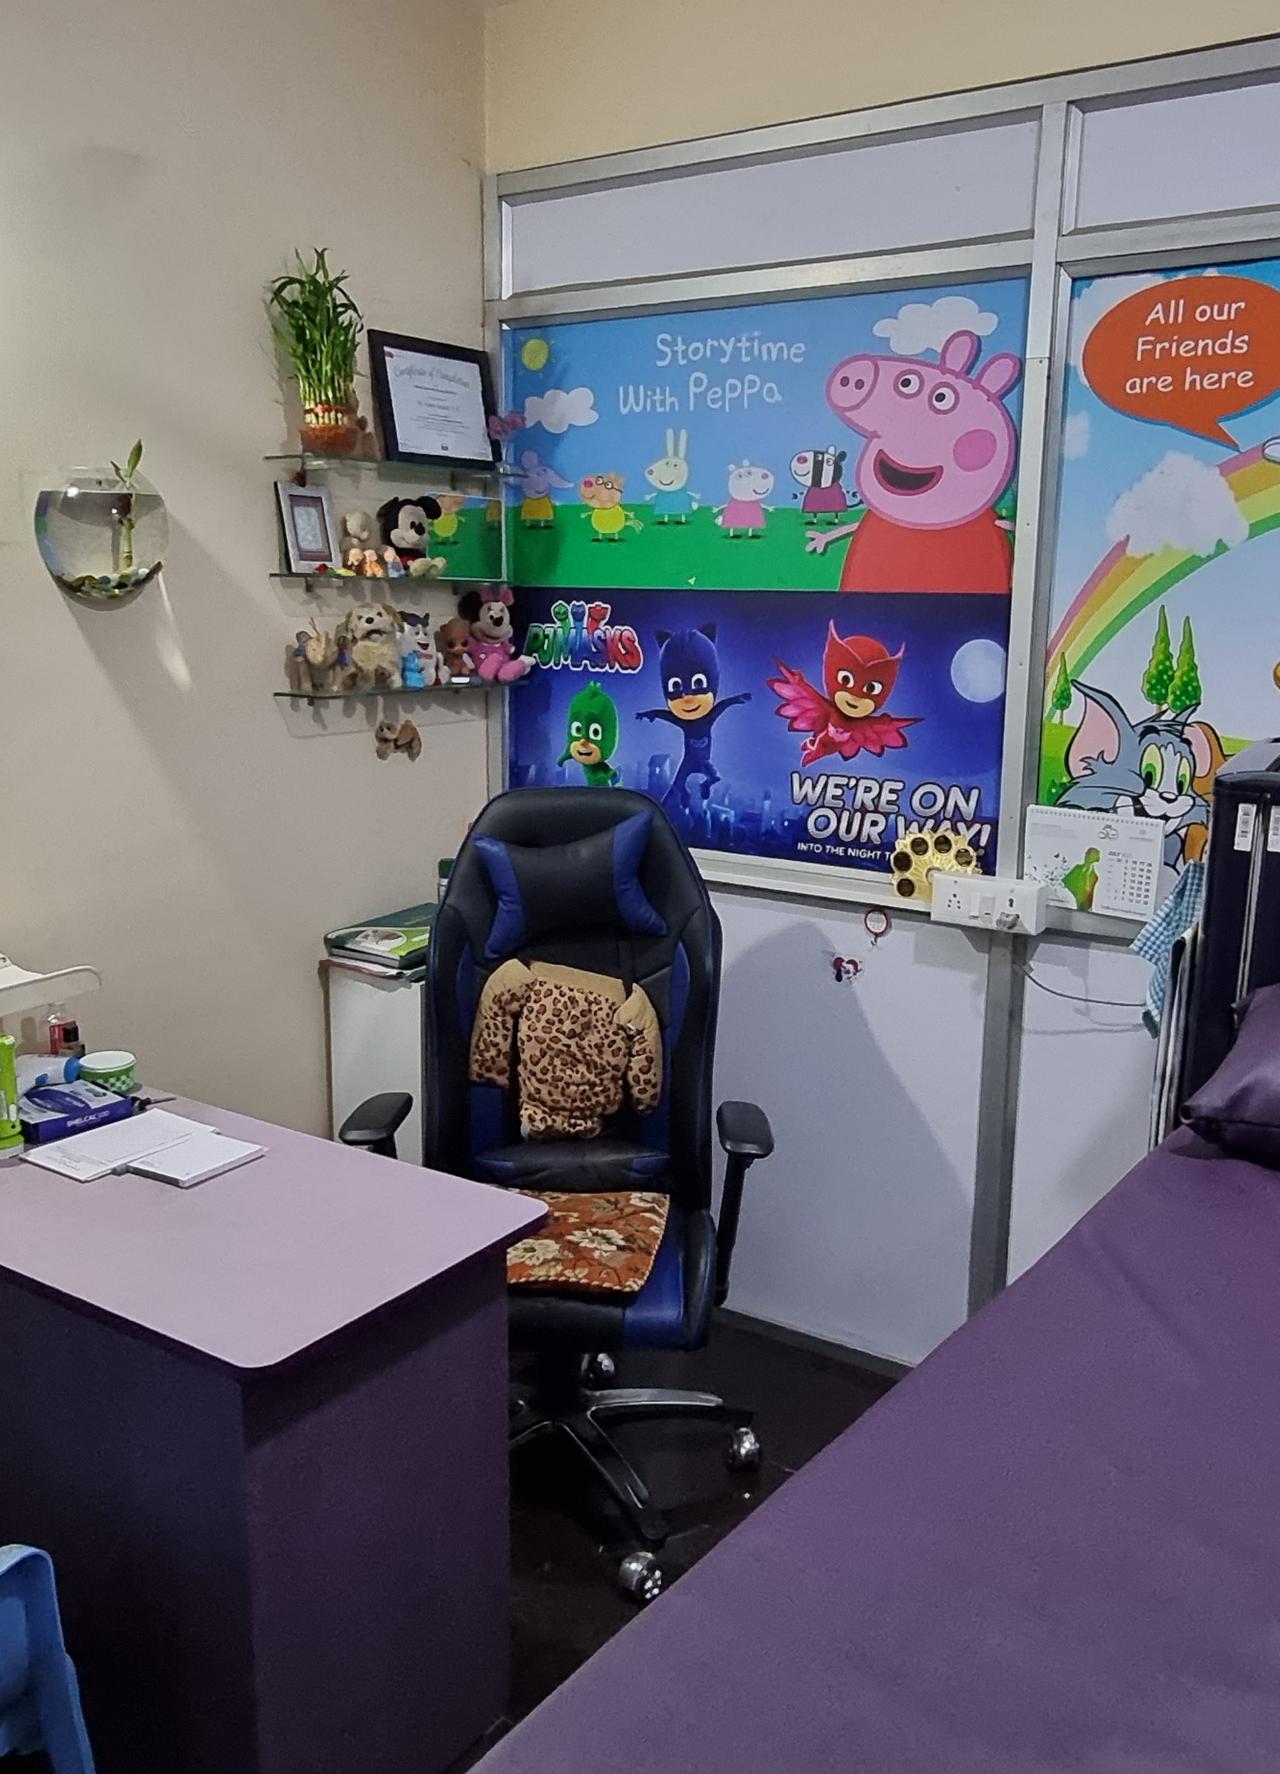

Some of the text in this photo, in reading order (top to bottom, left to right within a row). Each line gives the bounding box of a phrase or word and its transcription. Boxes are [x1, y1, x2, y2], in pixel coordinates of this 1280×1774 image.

[1144, 298, 1246, 327] All our
[655, 331, 806, 367] Storytime
[1136, 329, 1250, 362] Friends
[1125, 366, 1255, 395] are here
[619, 385, 679, 415] With
[790, 771, 981, 821] WE'RE ON
[806, 807, 887, 845] OUR
[797, 842, 823, 853] INTO
[825, 845, 845, 856] THE
[847, 848, 882, 860] NIGHT
